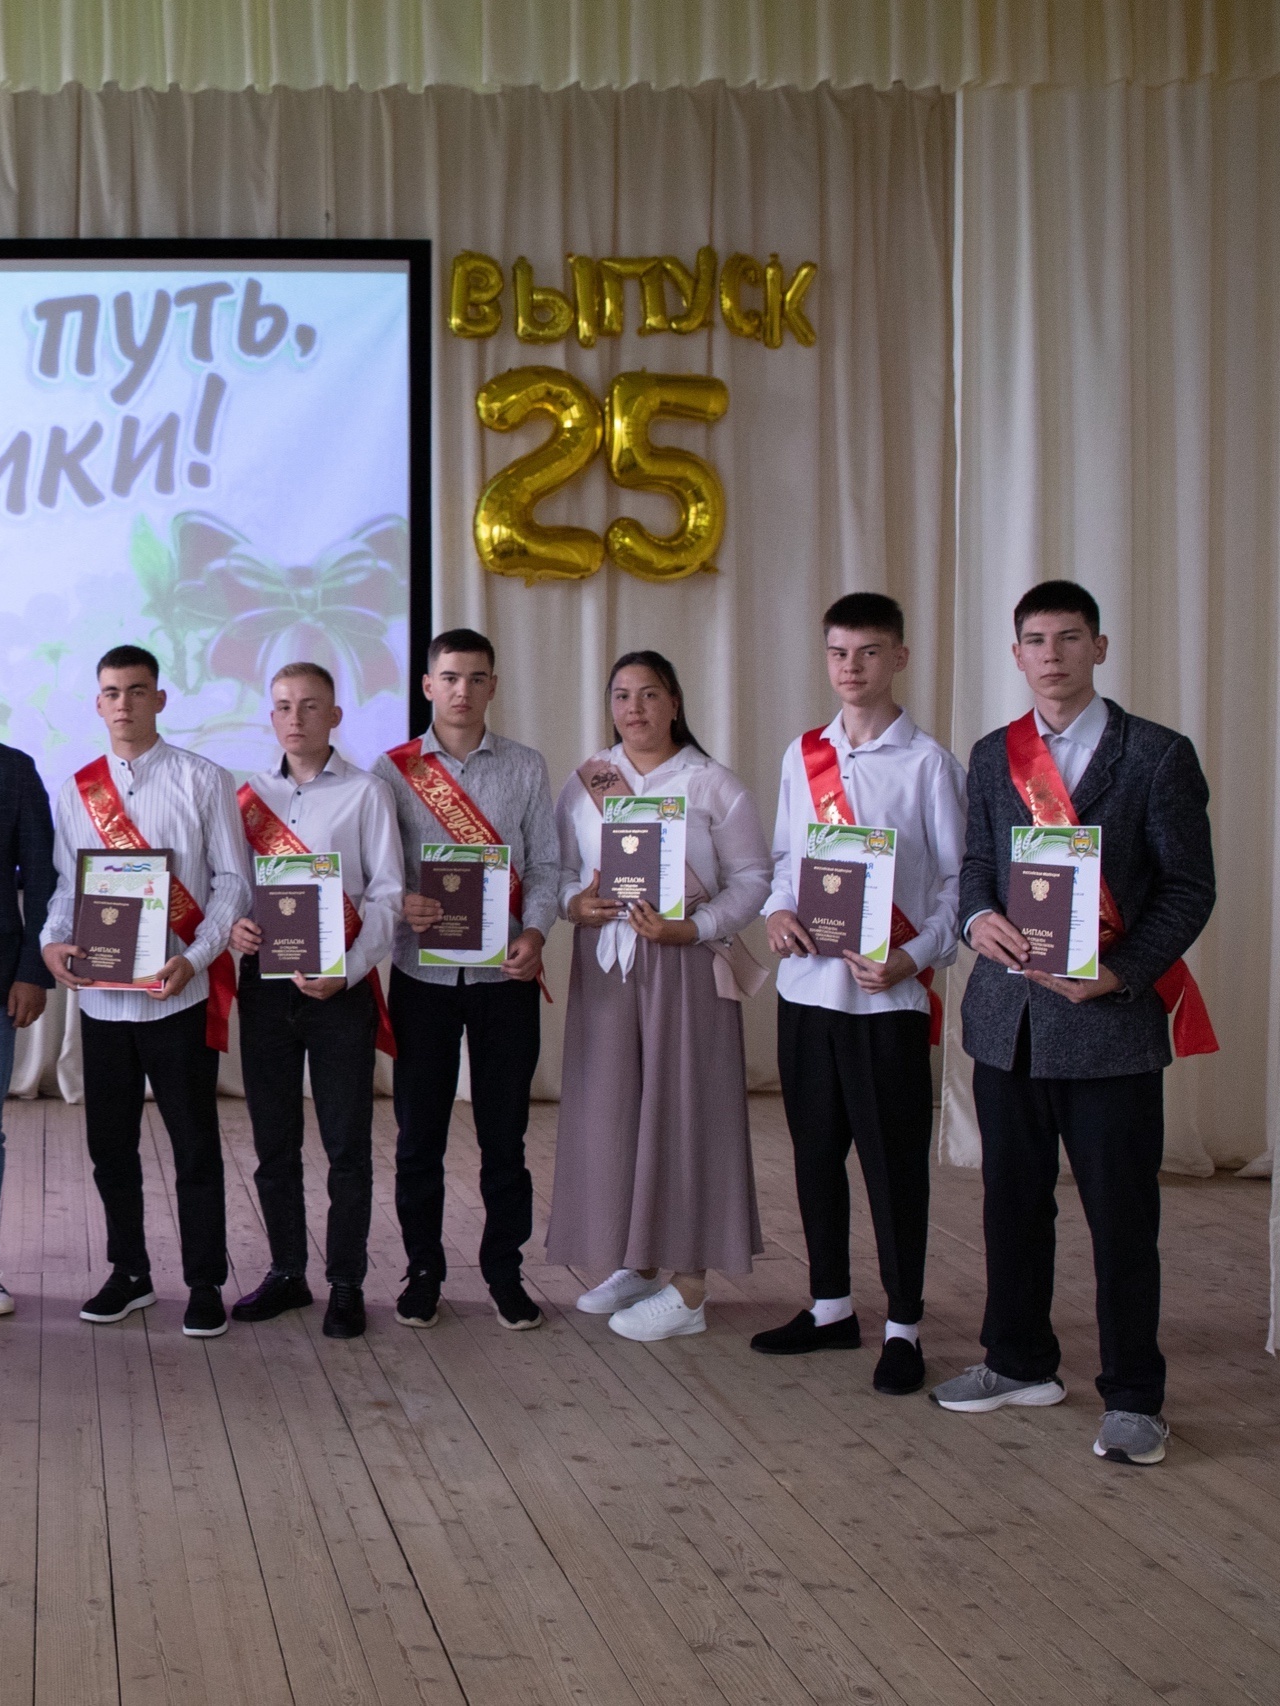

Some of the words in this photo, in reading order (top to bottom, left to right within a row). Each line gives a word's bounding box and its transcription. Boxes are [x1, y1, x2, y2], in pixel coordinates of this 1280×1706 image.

[449, 246, 817, 349] ВЫПУСК
[474, 365, 730, 578] 25
[812, 917, 845, 926] ДИПЛОМ
[1021, 928, 1053, 938] ДИПЛОМ
[89, 946, 120, 954] ДИПЛОМ
